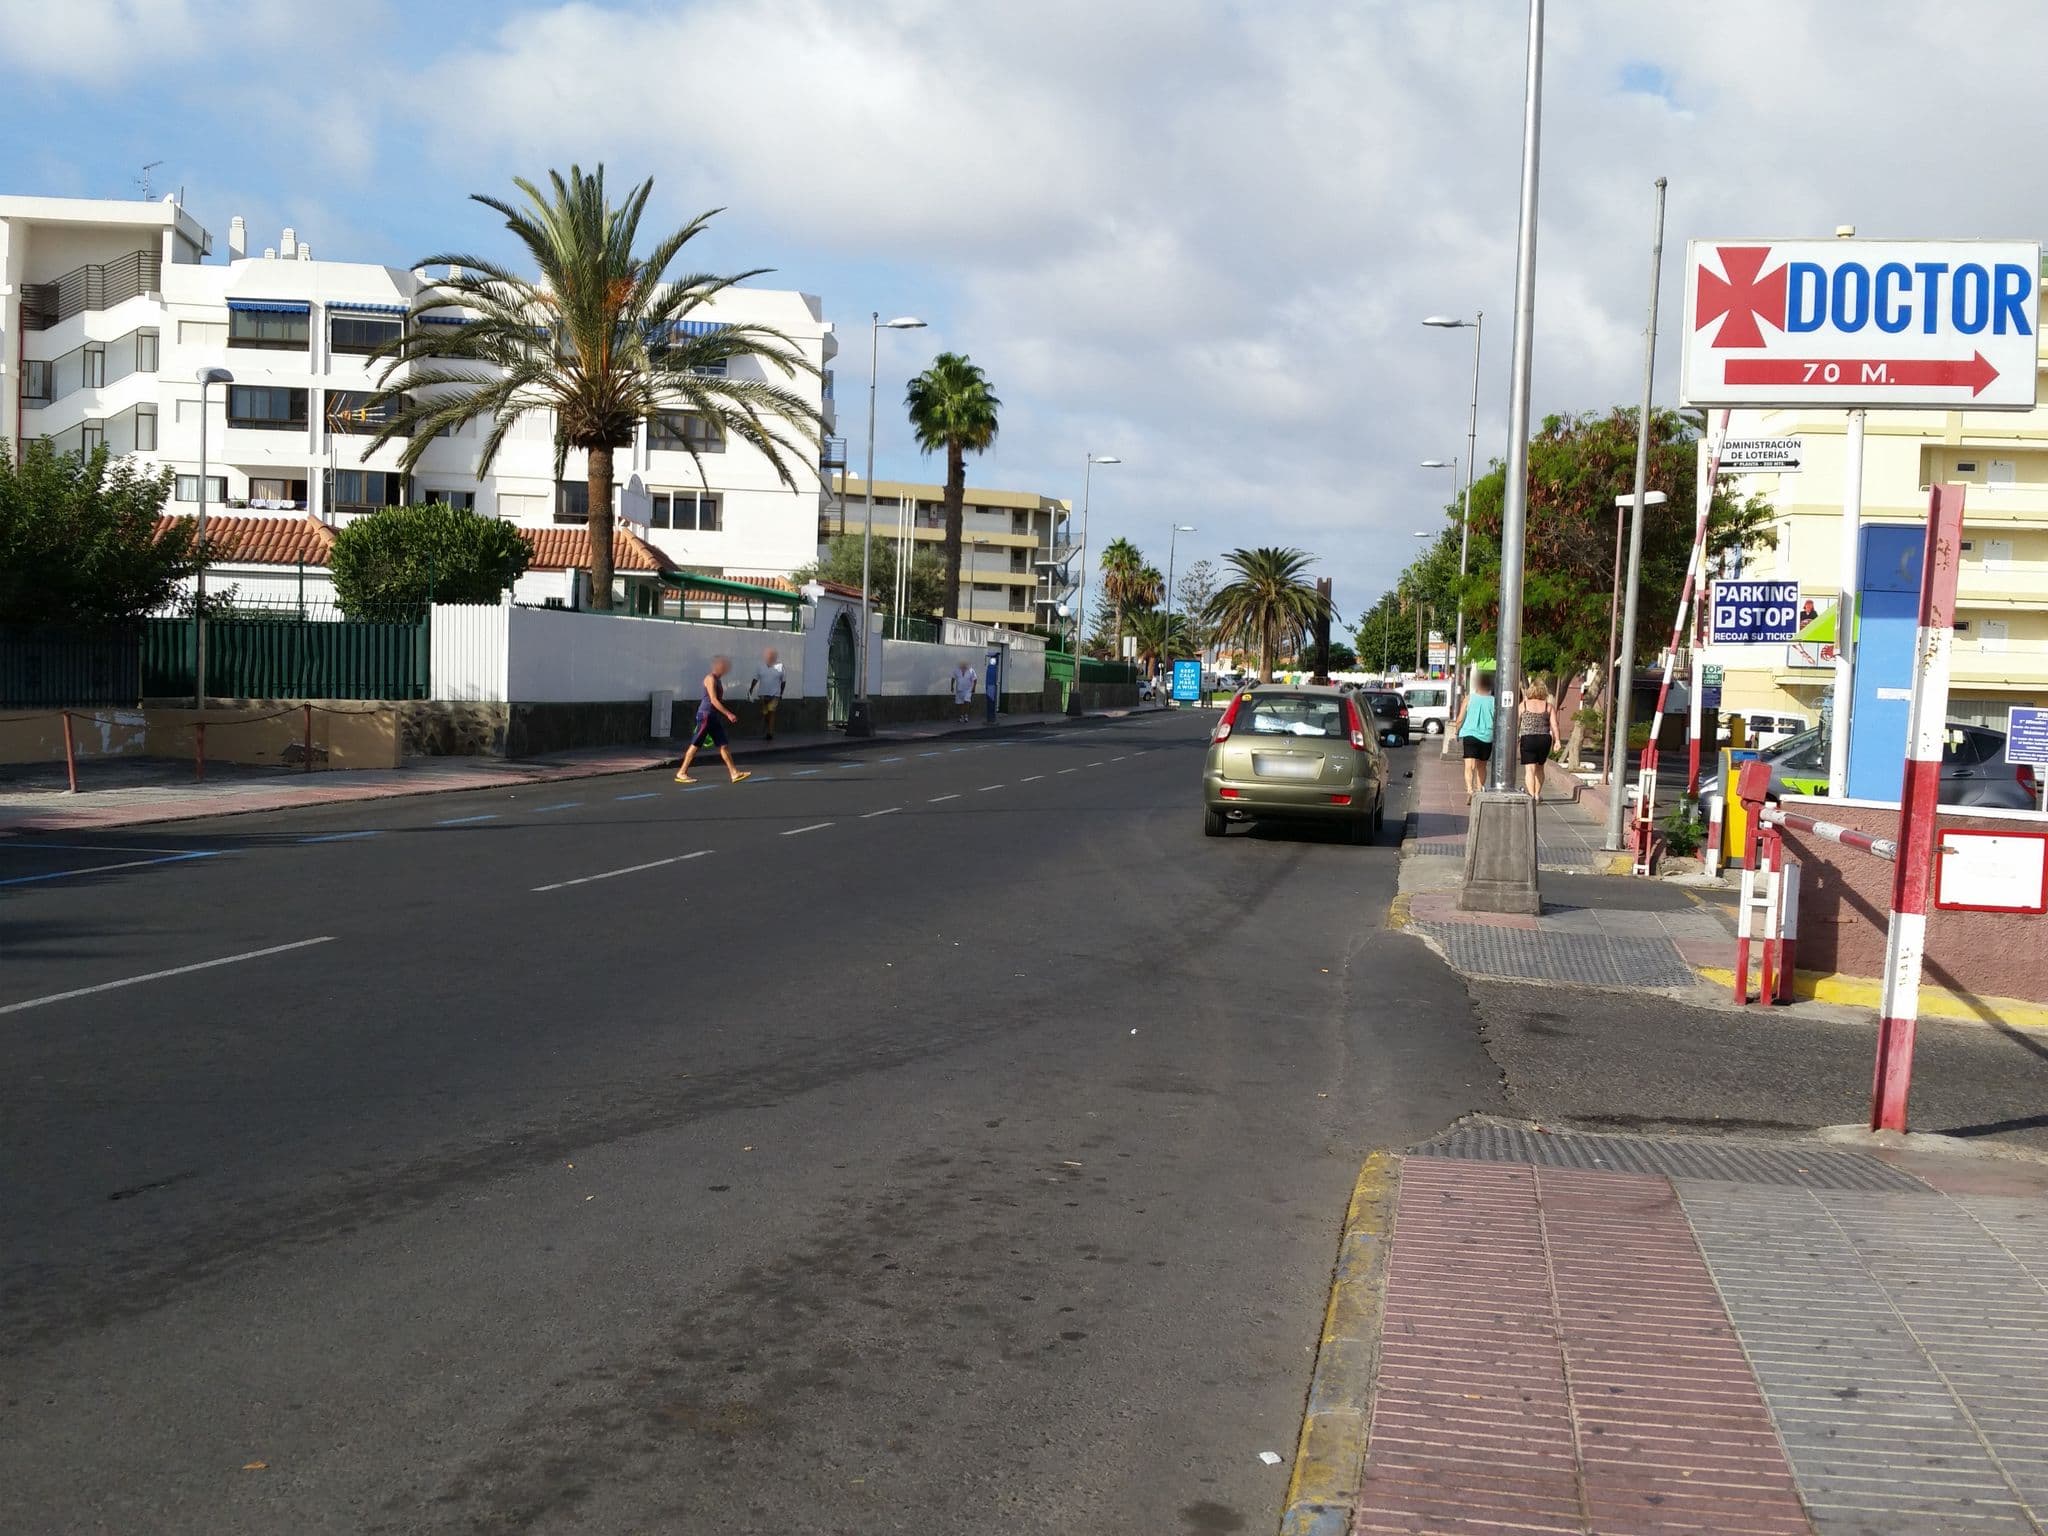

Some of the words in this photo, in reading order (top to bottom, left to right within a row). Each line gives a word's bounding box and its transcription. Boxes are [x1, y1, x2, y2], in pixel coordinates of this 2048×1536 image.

[1788, 262, 2033, 335] DOCTOR
[1802, 363, 1841, 383] 70
[1860, 363, 1896, 383] M.
[1731, 451, 1744, 459] DE
[1746, 449, 1789, 459] LOTERÍAS
[1716, 586, 1798, 602] PARKING
[1739, 607, 1795, 626] STOP
[1715, 632, 1749, 640] RECOJA
[1752, 632, 1763, 640] SU
